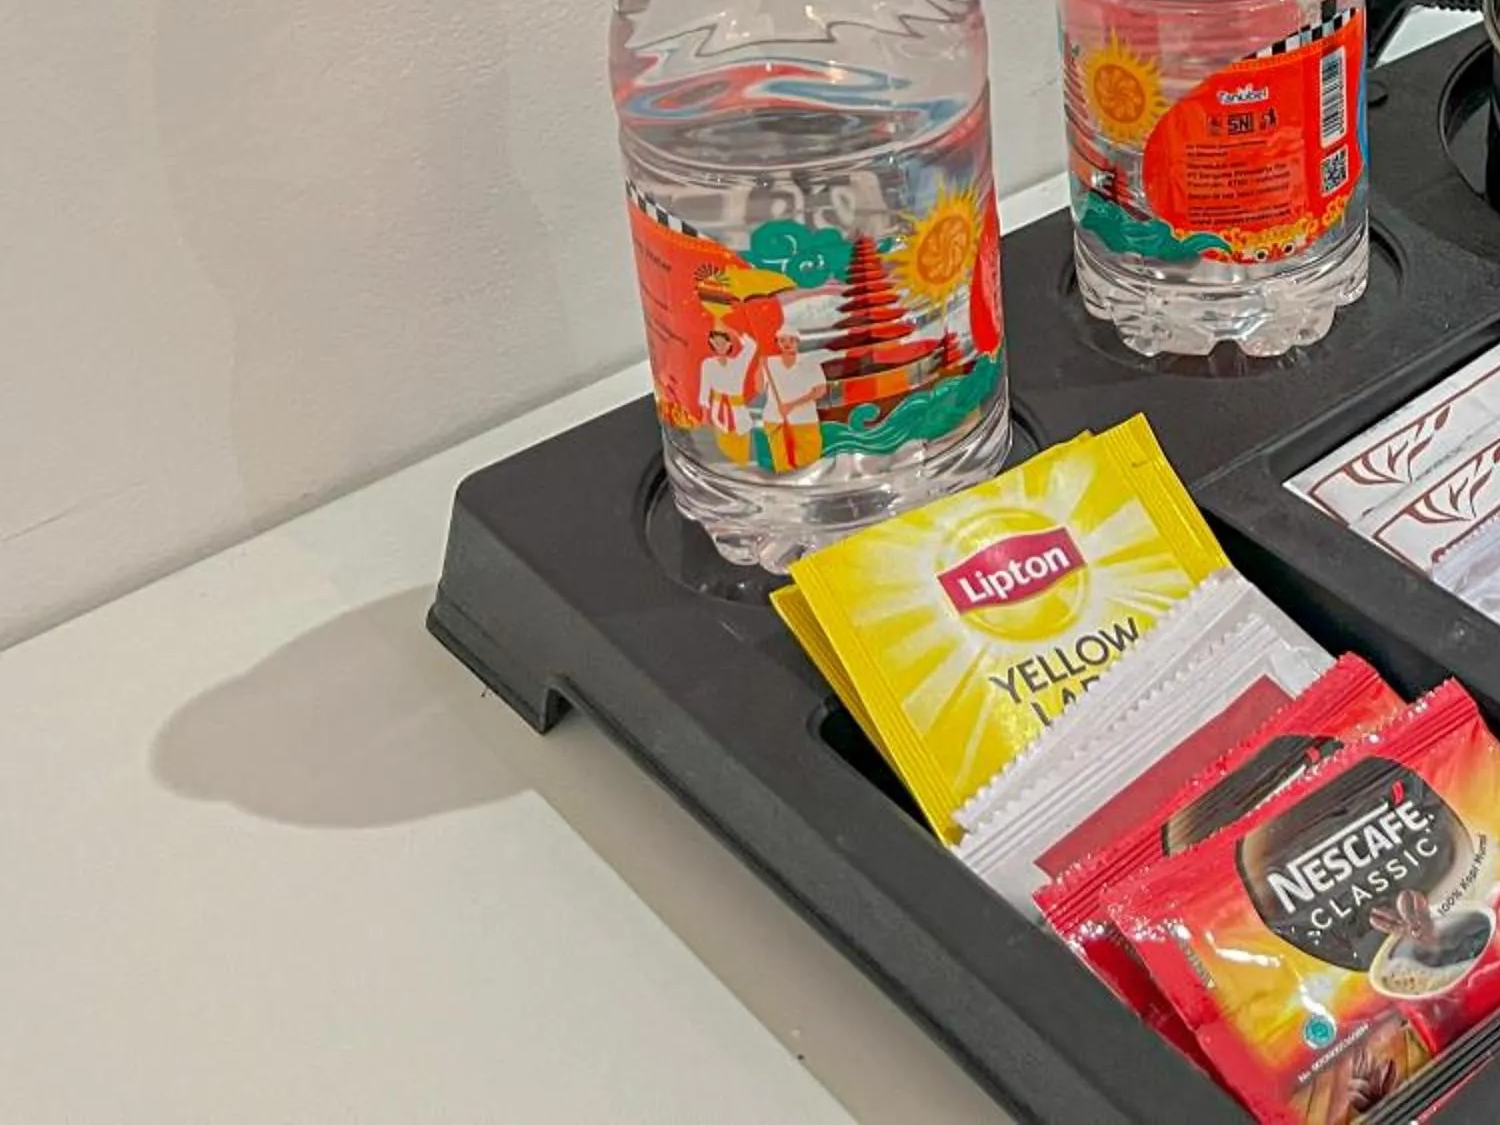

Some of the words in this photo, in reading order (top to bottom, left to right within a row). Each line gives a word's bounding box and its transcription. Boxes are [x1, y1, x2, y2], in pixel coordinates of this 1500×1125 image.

[1229, 114, 1254, 134] SNI
[957, 546, 1070, 603] Lipton
[988, 617, 1140, 705] YELLOW
[1311, 838, 1438, 930] CLASSIC
[1437, 889, 1462, 916] 100%
